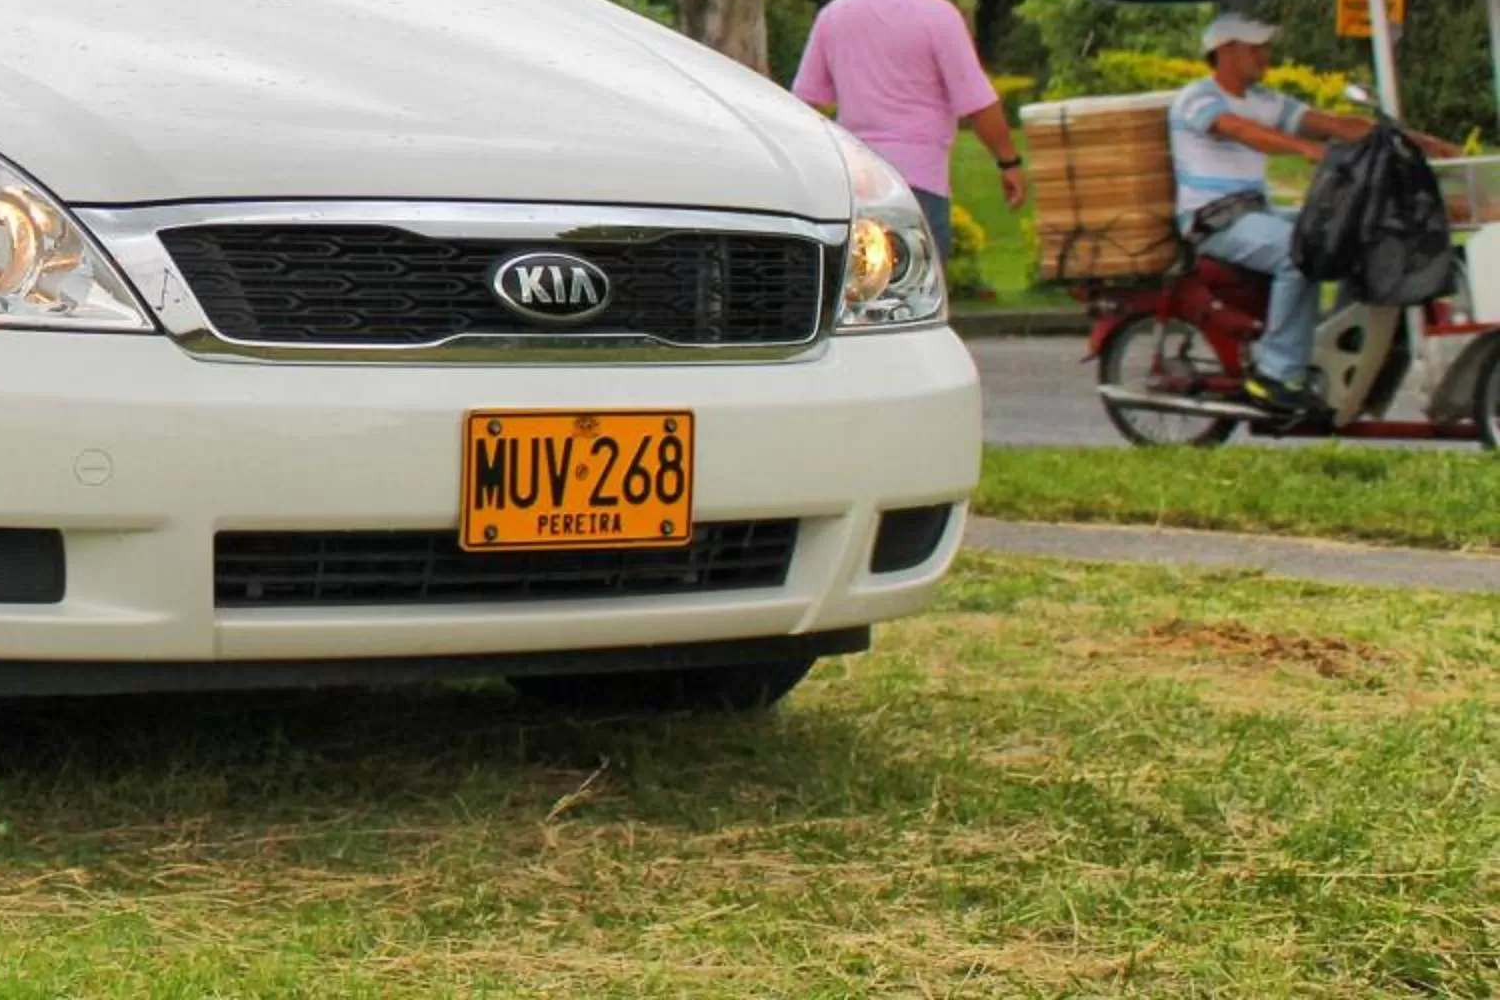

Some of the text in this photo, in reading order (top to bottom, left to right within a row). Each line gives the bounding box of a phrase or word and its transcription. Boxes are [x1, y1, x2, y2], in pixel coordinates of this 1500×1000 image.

[515, 264, 600, 305] KIA
[474, 434, 685, 511] MUV 268
[536, 513, 622, 536] PEREIRA
